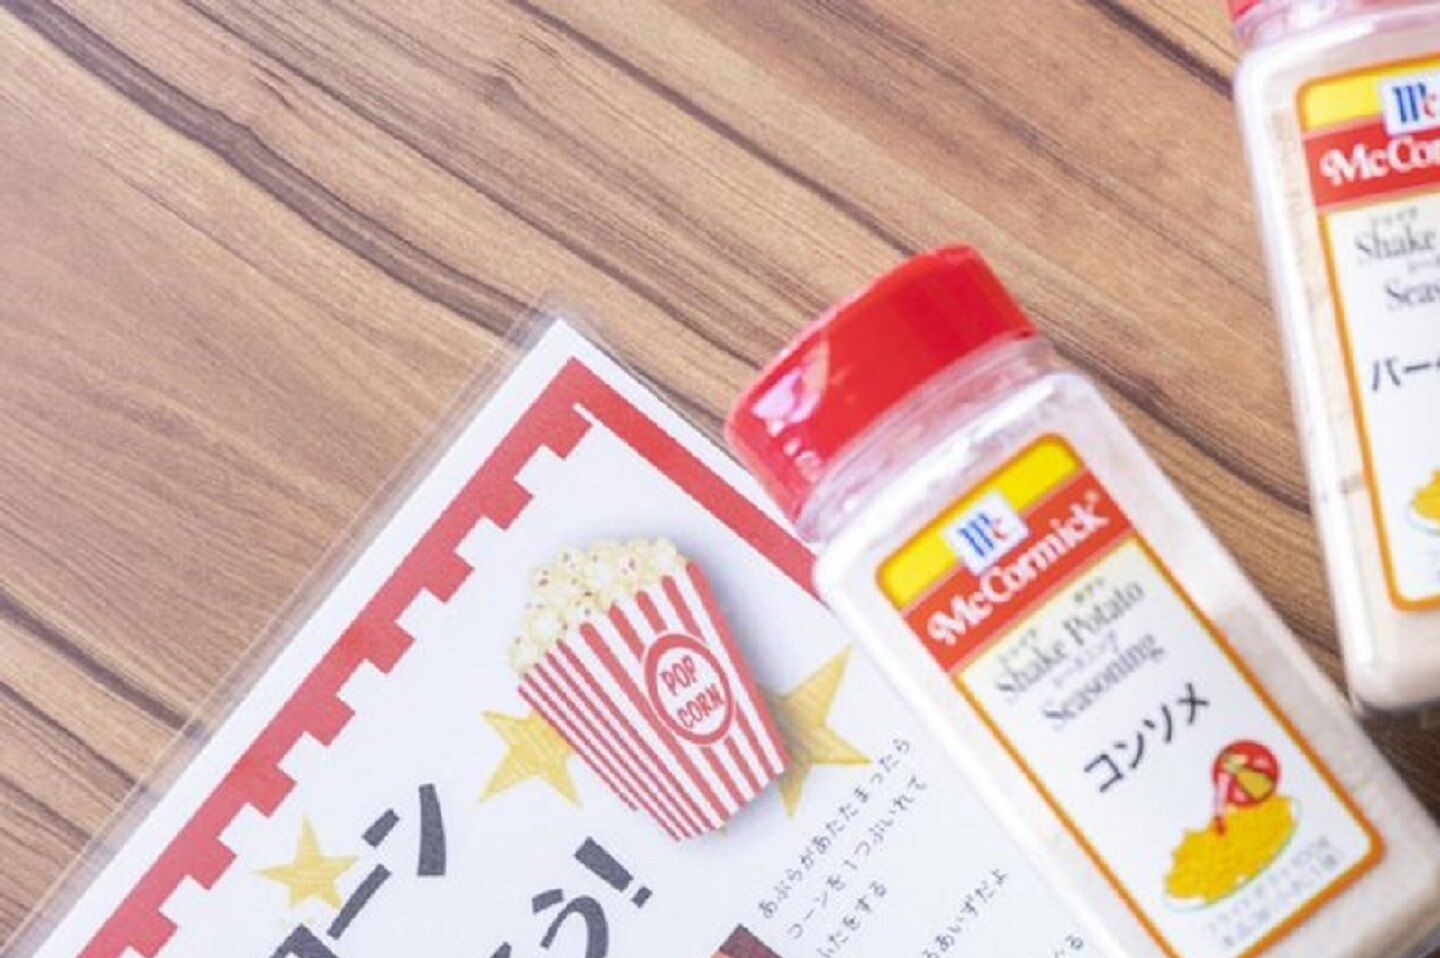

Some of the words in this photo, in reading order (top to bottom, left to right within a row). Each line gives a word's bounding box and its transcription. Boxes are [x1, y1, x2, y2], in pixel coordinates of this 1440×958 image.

[1355, 224, 1436, 265] Shake
[995, 638, 1068, 703] Shake
[1062, 578, 1145, 648] Potato
[659, 655, 698, 697] POP
[676, 686, 726, 729] CORN
[1042, 631, 1165, 727] Seasoning
[1084, 682, 1210, 793] コンソメ
